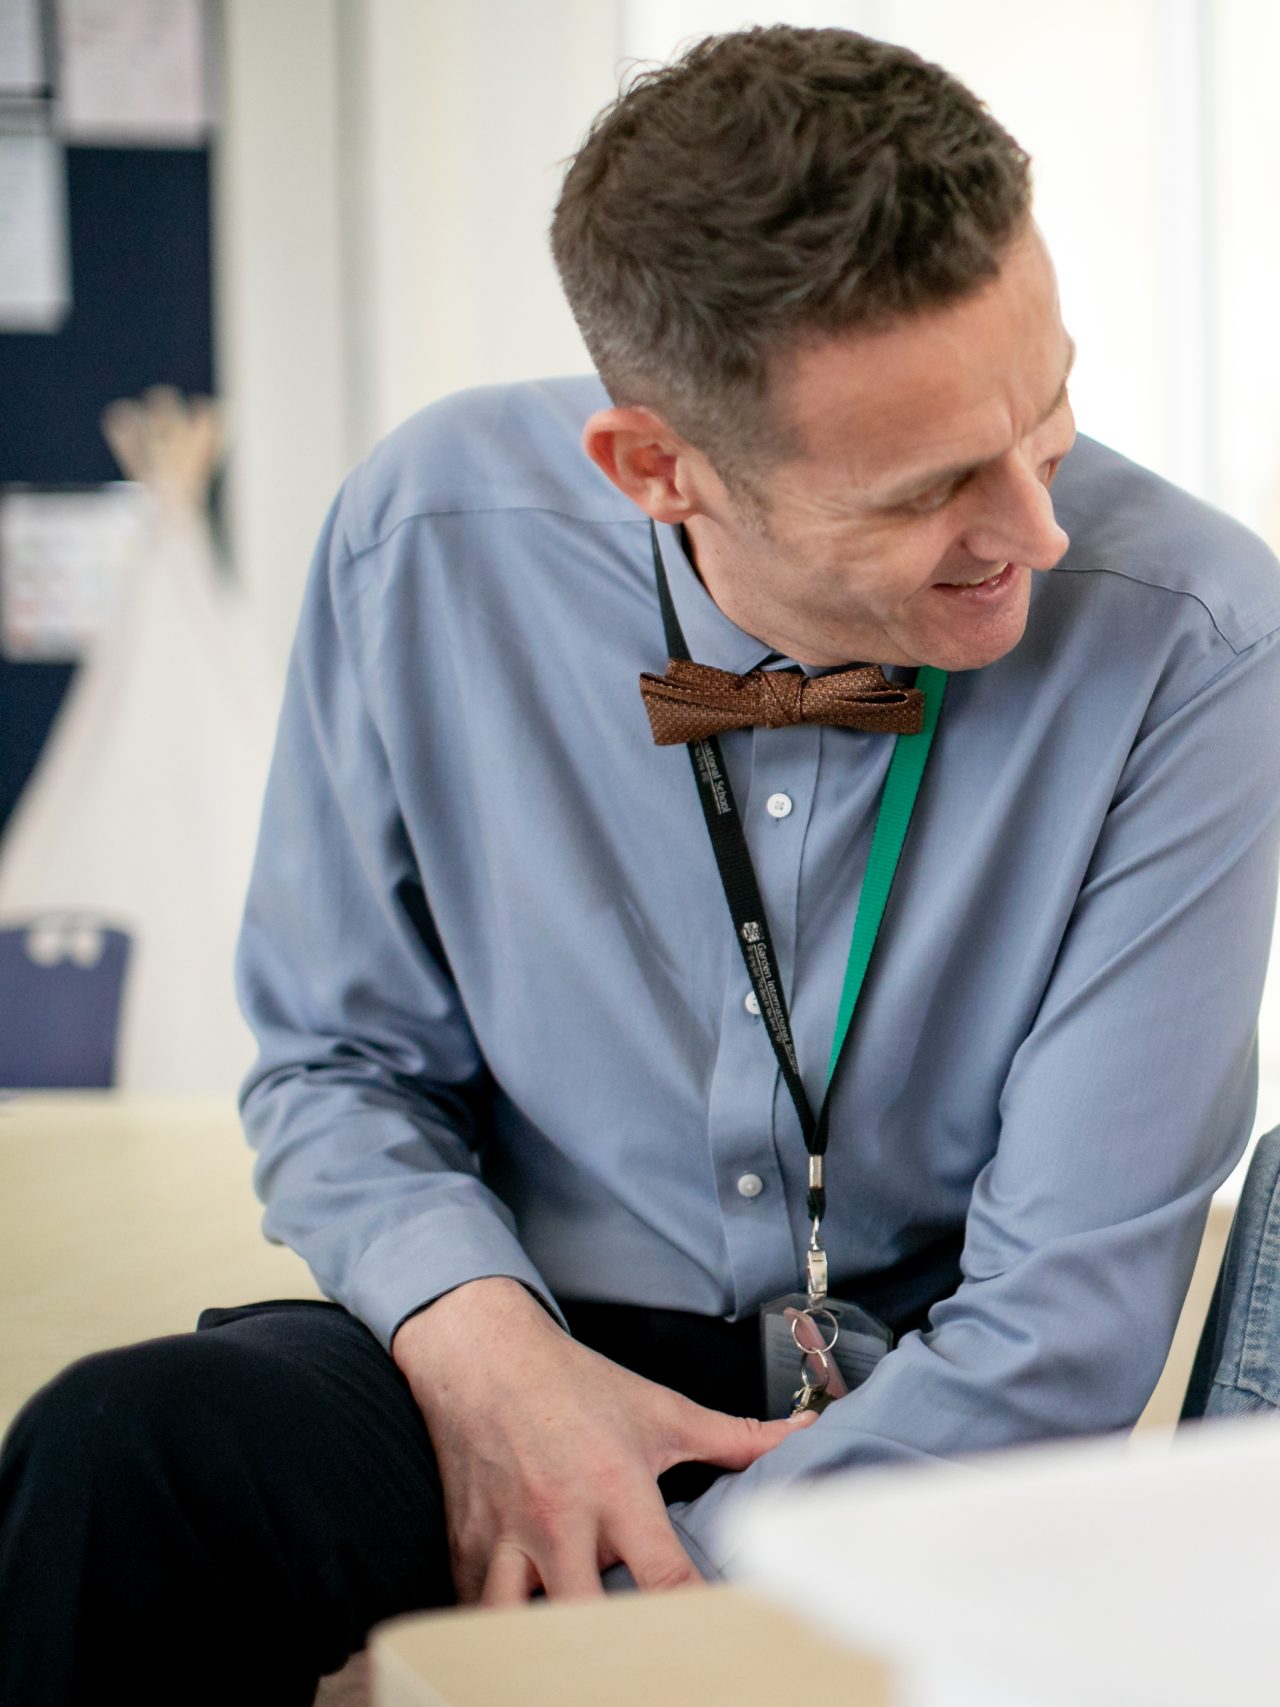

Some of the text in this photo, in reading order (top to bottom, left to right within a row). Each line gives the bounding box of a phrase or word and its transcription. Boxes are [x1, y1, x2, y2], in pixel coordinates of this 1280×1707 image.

[704, 740, 732, 813] national School
[757, 942, 772, 979] Garden
[767, 980, 790, 1041] International
